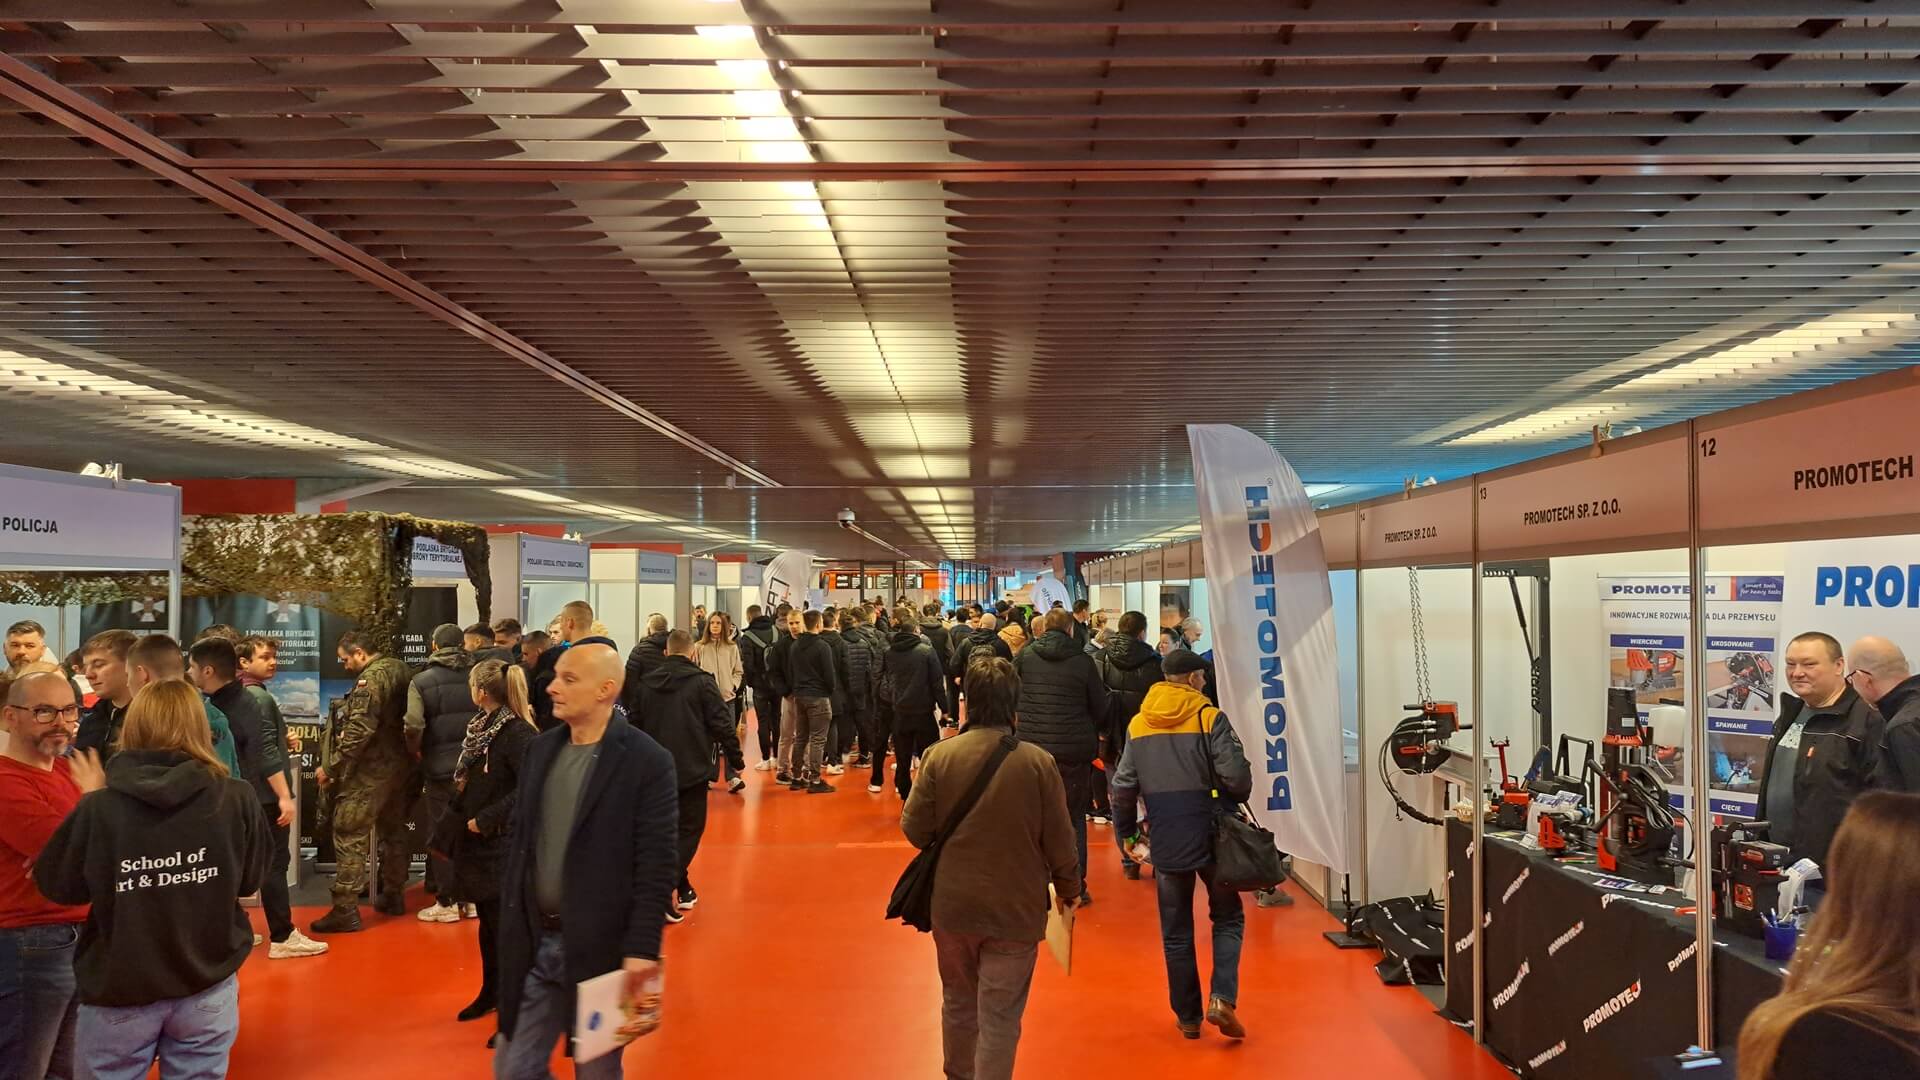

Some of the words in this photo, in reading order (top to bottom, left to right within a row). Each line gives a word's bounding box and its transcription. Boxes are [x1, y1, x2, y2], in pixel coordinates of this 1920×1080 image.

[1701, 438, 1716, 457] 12
[1794, 455, 1913, 490] PROMOTECH
[1480, 488, 1487, 500] 13
[1524, 504, 1575, 526] PROMOTECH
[1577, 503, 1590, 519] SP.
[1592, 502, 1599, 516] Z
[1601, 499, 1621, 515] O.O.
[3, 516, 58, 534] POLICJA
[1385, 529, 1413, 543] PROMOTECH
[1422, 528, 1426, 538] Z
[1612, 585, 1715, 594] PROMOTEH
[1610, 612, 1658, 620] INNOWACYJNE
[1712, 612, 1726, 620] DLA
[1728, 612, 1776, 621] PRZEMYSŁU
[1630, 638, 1663, 646] WIERCENIE
[1711, 640, 1754, 648] UKOSOWANIE
[1715, 721, 1748, 730] SPAWANIE
[121, 851, 182, 873] School
[187, 847, 207, 863] of
[139, 874, 153, 888] &
[158, 866, 218, 886] Design
